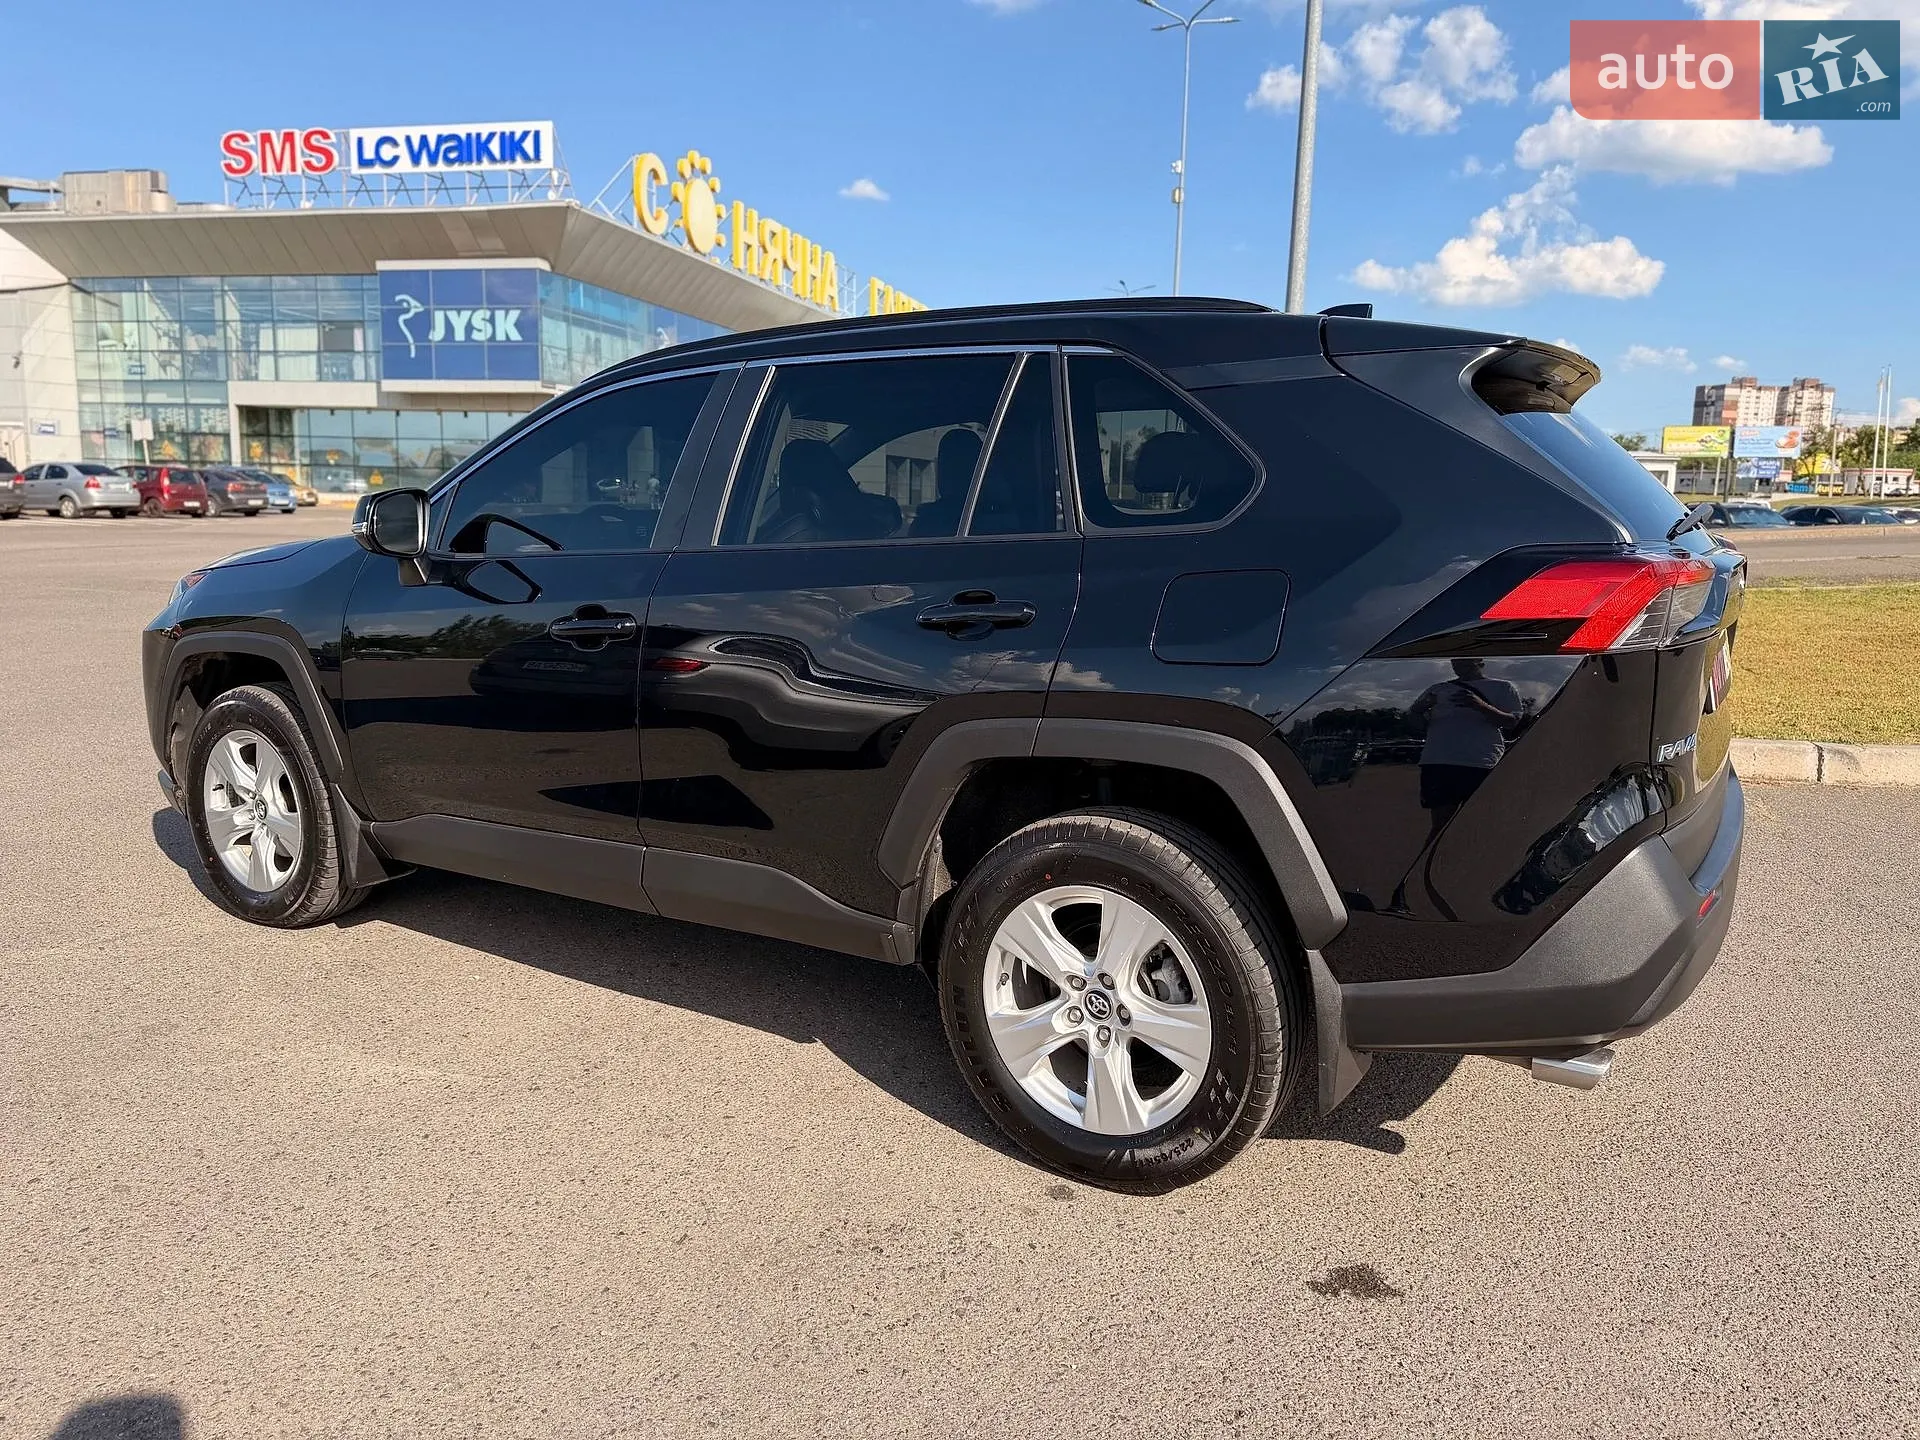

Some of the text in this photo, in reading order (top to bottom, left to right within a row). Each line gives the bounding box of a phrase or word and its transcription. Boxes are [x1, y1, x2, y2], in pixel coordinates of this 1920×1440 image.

[221, 128, 336, 176] SMS
[356, 136, 400, 169] LC
[428, 309, 523, 342] JYSK
